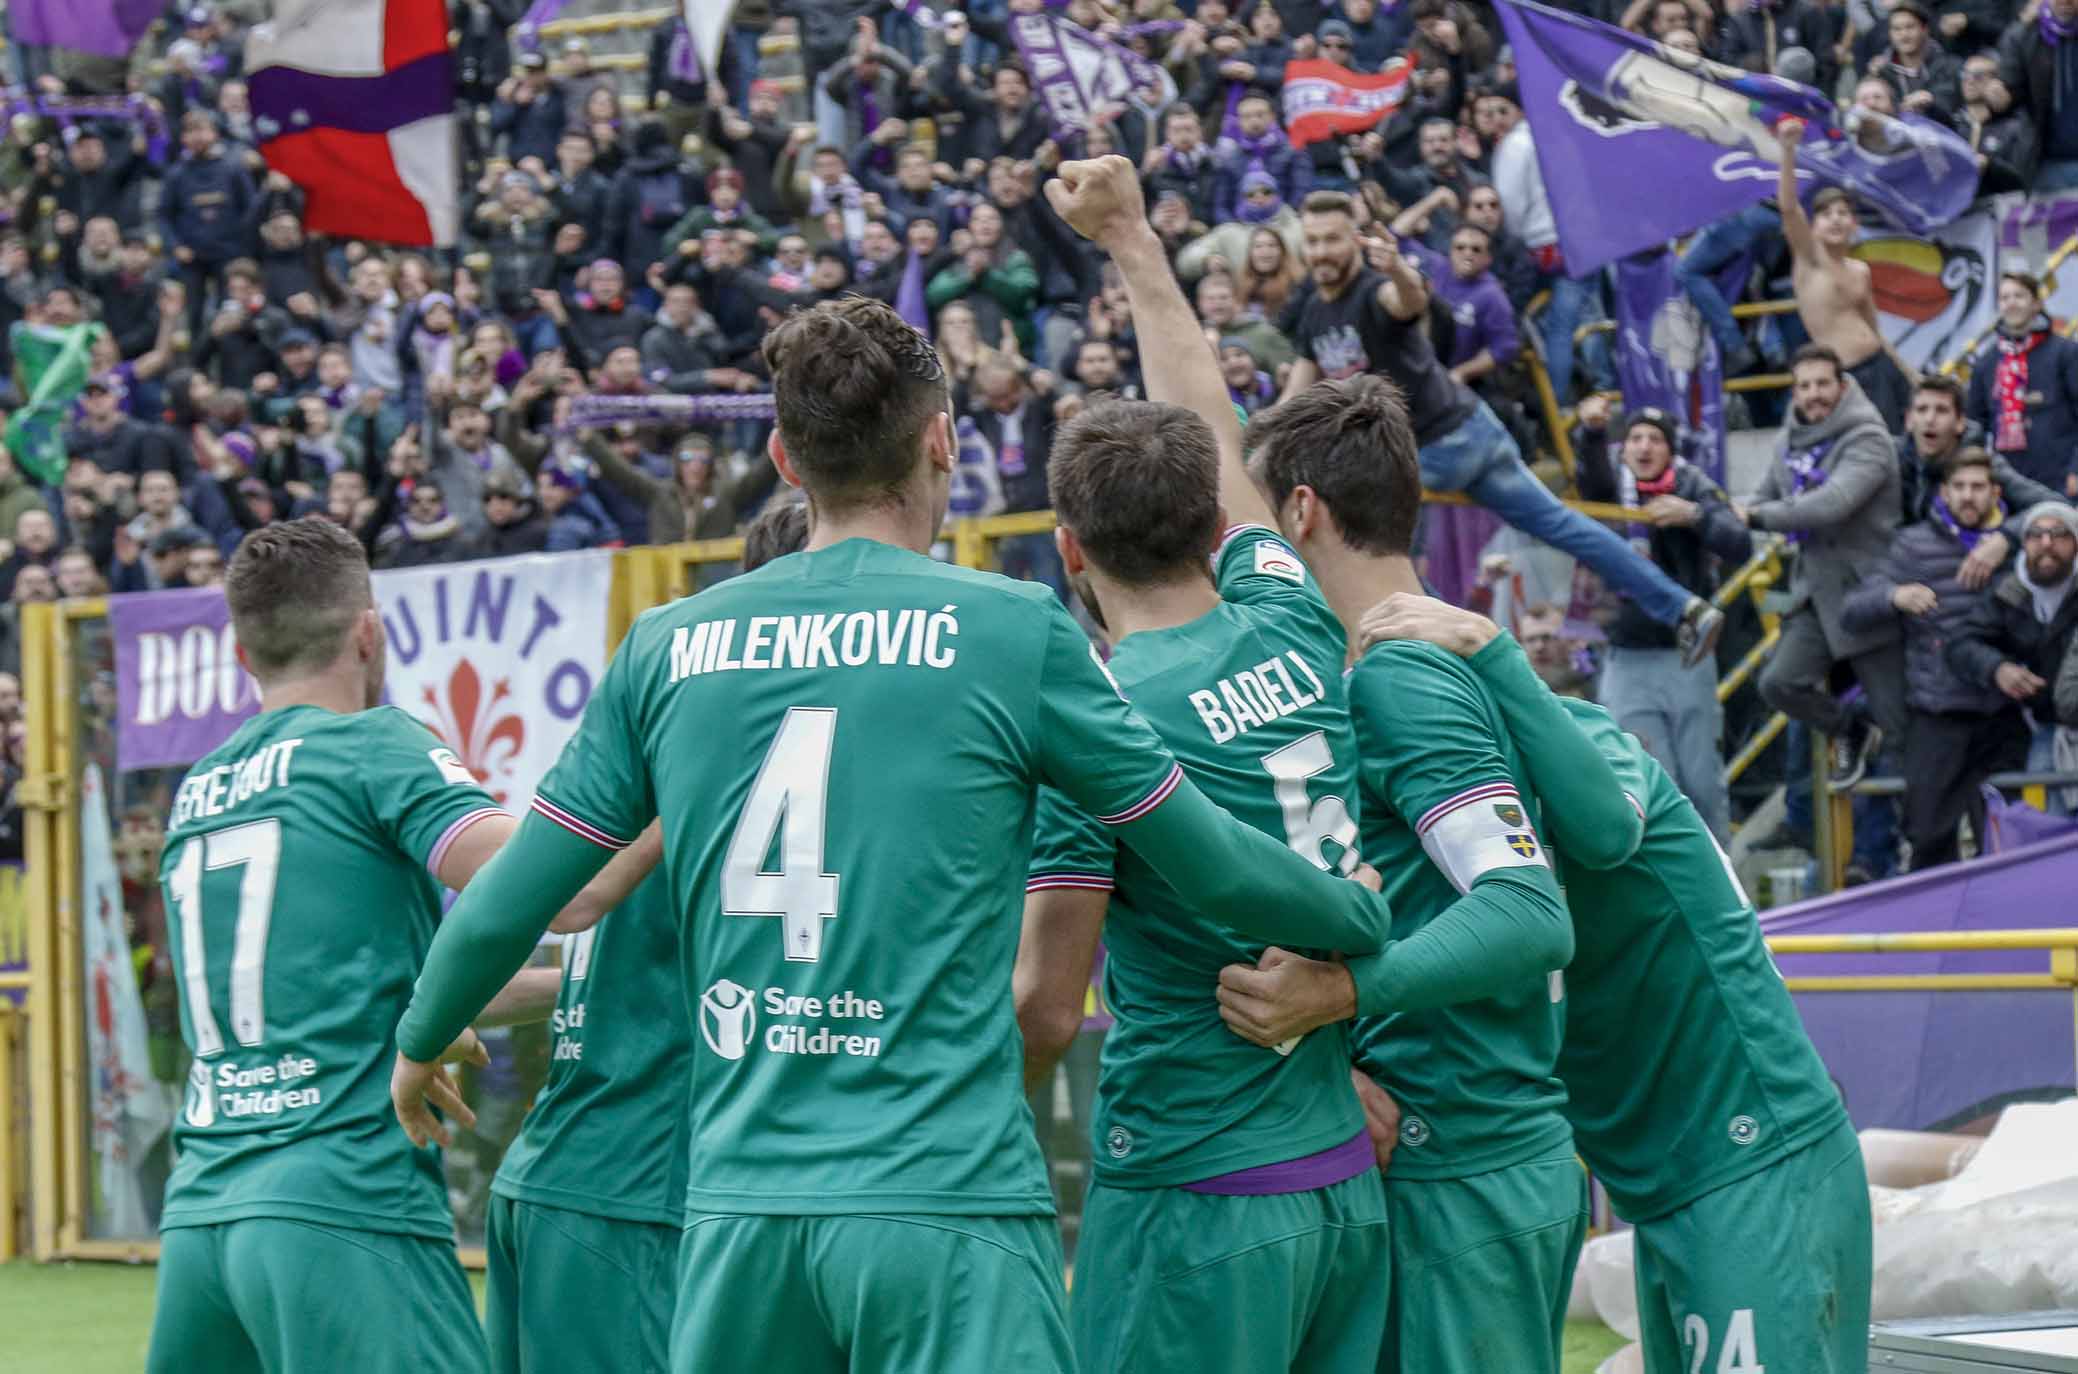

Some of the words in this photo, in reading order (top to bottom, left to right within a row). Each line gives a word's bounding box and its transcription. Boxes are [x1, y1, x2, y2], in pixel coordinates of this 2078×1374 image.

[379, 569, 592, 721] UINTO
[669, 604, 959, 682] MILENKOVIĆ
[1188, 650, 1325, 745] BADELJ
[720, 706, 840, 962] 4
[170, 817, 282, 1057] 17
[827, 990, 885, 1020] the
[1684, 1309, 1766, 1374] 24
